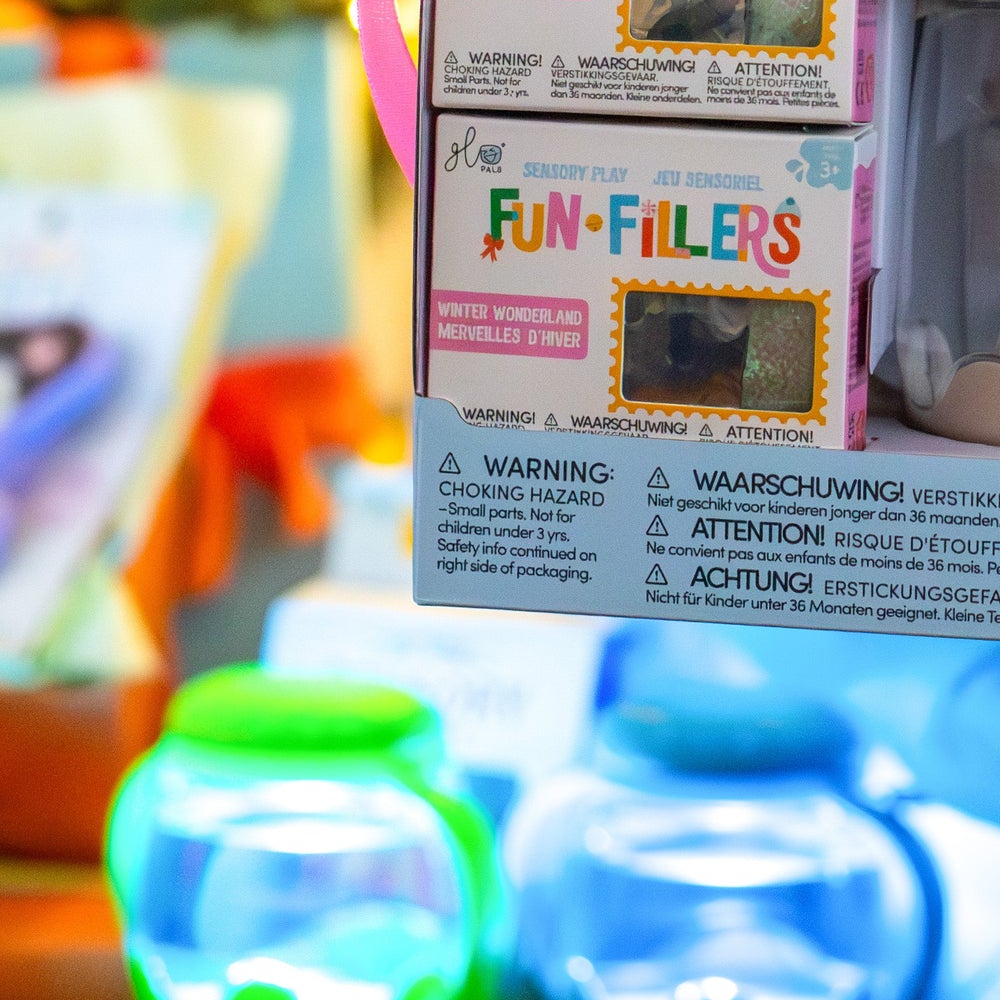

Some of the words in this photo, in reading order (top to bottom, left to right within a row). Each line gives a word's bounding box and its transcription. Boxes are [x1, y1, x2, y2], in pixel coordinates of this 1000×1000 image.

[469, 51, 542, 67] WARNING!
[578, 55, 696, 73] WAARSCHUWING!
[735, 62, 822, 78] ATTENTION!
[444, 65, 489, 75] CHOKING
[492, 66, 532, 77] HAZARD
[551, 69, 658, 82] VERSTIKKINGSGEVAAR.
[707, 76, 743, 86] RISQUE
[523, 161, 589, 181] SENSORY
[591, 165, 628, 183] PLAY
[653, 169, 681, 187] JEU
[685, 171, 764, 191] SENSORIEL
[490, 188, 582, 252] FUN
[438, 301, 488, 320] WINTER
[493, 303, 582, 325] WONDERLAND
[438, 322, 521, 344] MERVEILLES
[528, 328, 581, 348] D'HIVER
[463, 407, 535, 424] WARNING!
[571, 414, 688, 435] WAARSCHUWING!
[726, 425, 813, 443] ATTENTION!
[484, 454, 615, 484] WARNING:
[438, 481, 525, 501] CHOKING
[530, 487, 605, 507] HAZARD
[693, 469, 904, 503] WAARSCHUWING!
[489, 506, 527, 523] parts.
[530, 508, 554, 522] Not
[555, 509, 575, 523] for
[647, 493, 673, 507] Niet
[677, 497, 732, 511] geschikt
[735, 501, 766, 513] voor
[768, 499, 827, 517] kinderen
[829, 506, 876, 523] jonger
[878, 508, 906, 523] dan
[909, 510, 926, 523] 36
[438, 521, 491, 537] children
[494, 524, 534, 539] under
[536, 527, 545, 539] 3
[547, 530, 571, 544] yrs.
[691, 516, 825, 546] ATTENTION!
[835, 532, 903, 551] RISQUE
[438, 539, 480, 557] Safety
[482, 541, 507, 556] info
[510, 543, 576, 561] continued
[579, 550, 597, 562] on
[647, 541, 665, 555] Ne
[668, 544, 725, 559] convient
[728, 550, 754, 563] pas
[756, 551, 782, 562] aux
[785, 550, 836, 566] enfants
[839, 553, 858, 567] de
[861, 556, 902, 570] moins
[906, 557, 924, 571] de
[927, 558, 944, 572] 36
[947, 561, 984, 575] mois.
[437, 557, 468, 575] right
[470, 560, 498, 574] side
[500, 561, 515, 575] of
[517, 562, 592, 584] packaging.
[690, 566, 813, 594] ACHTUNG!
[646, 590, 680, 605] Nicht
[682, 592, 702, 606] für
[705, 593, 748, 608] Kinder
[751, 598, 787, 611] unter
[790, 599, 806, 612] 36
[809, 600, 873, 616] Monaten
[876, 605, 940, 622] geeignet.
[944, 608, 984, 623] Kleine
